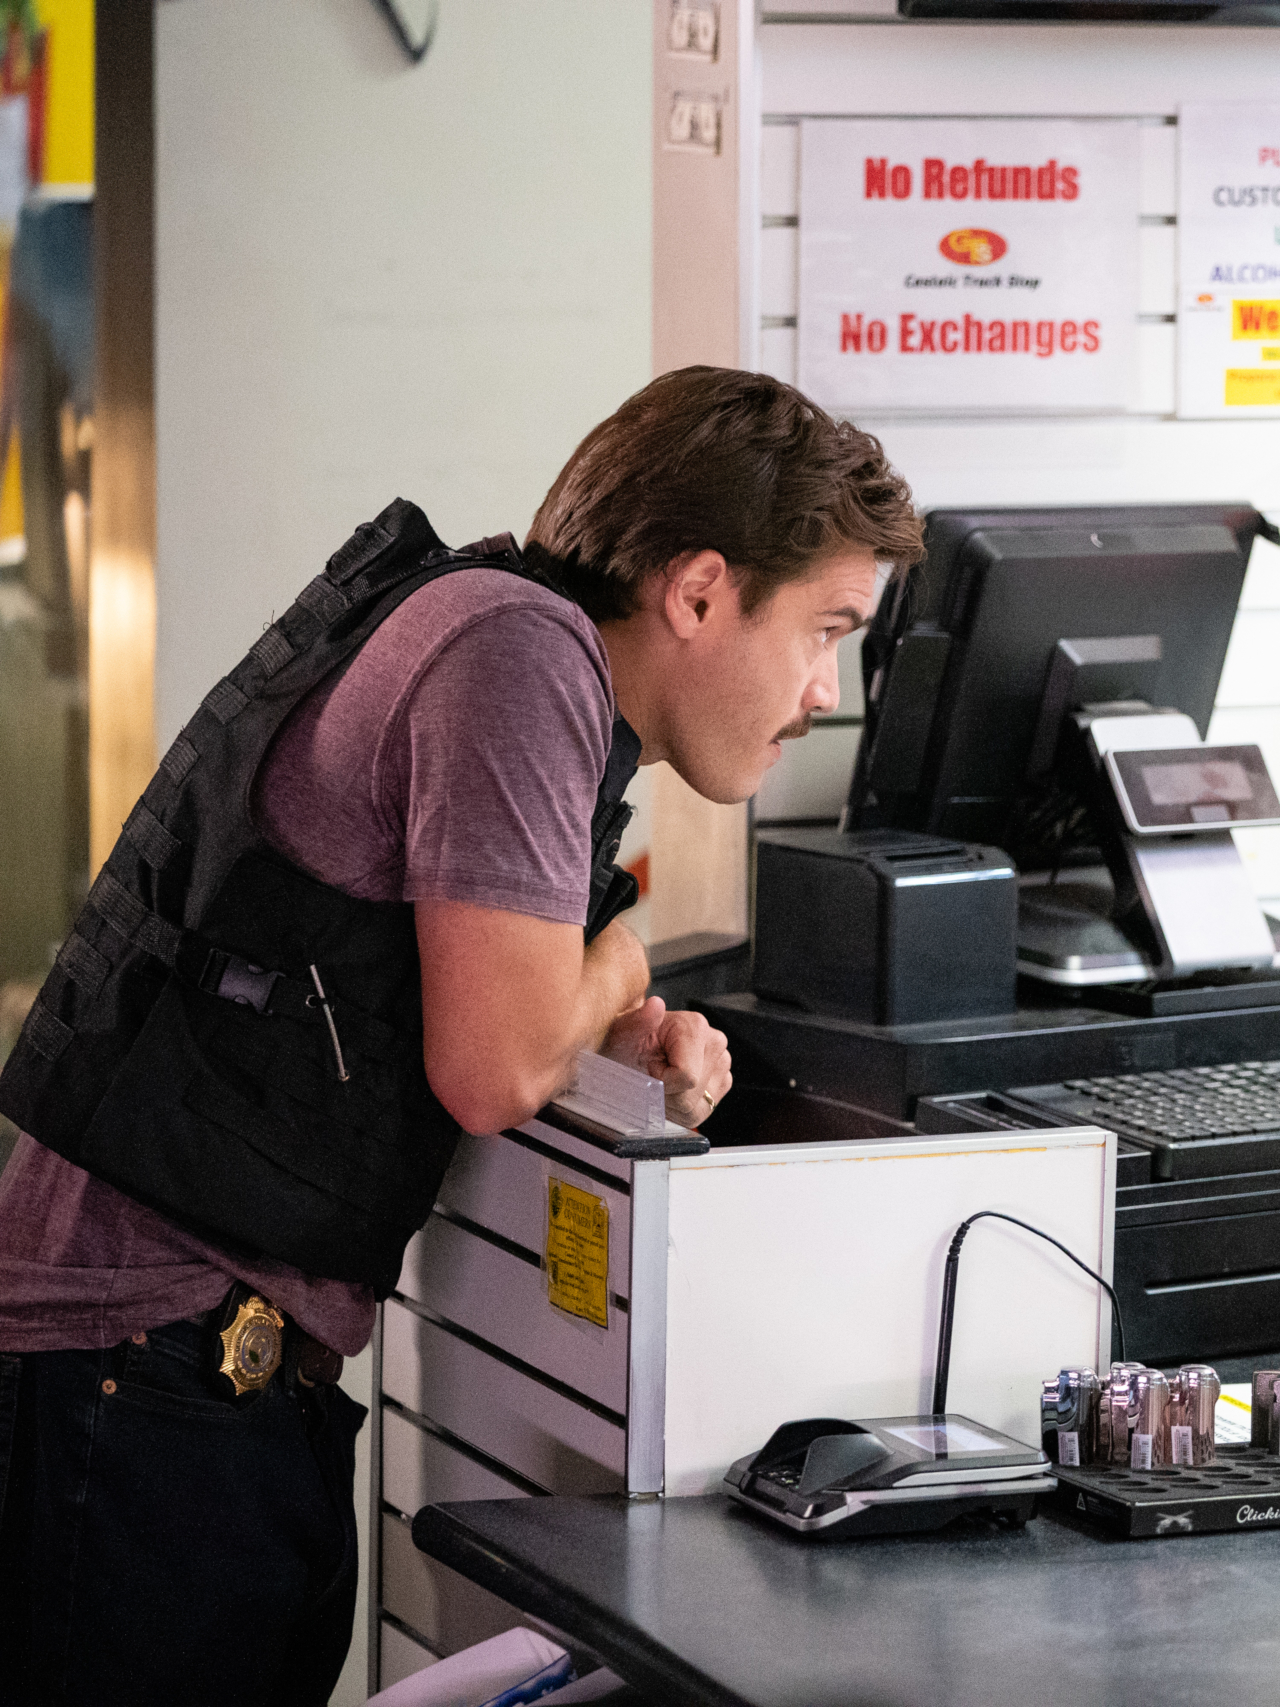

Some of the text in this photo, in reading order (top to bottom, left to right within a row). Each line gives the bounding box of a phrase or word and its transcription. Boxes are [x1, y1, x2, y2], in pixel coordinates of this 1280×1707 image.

[864, 157, 1080, 201] No Refunds
[839, 312, 1102, 359] No Exchanges
[1239, 304, 1280, 332] We
